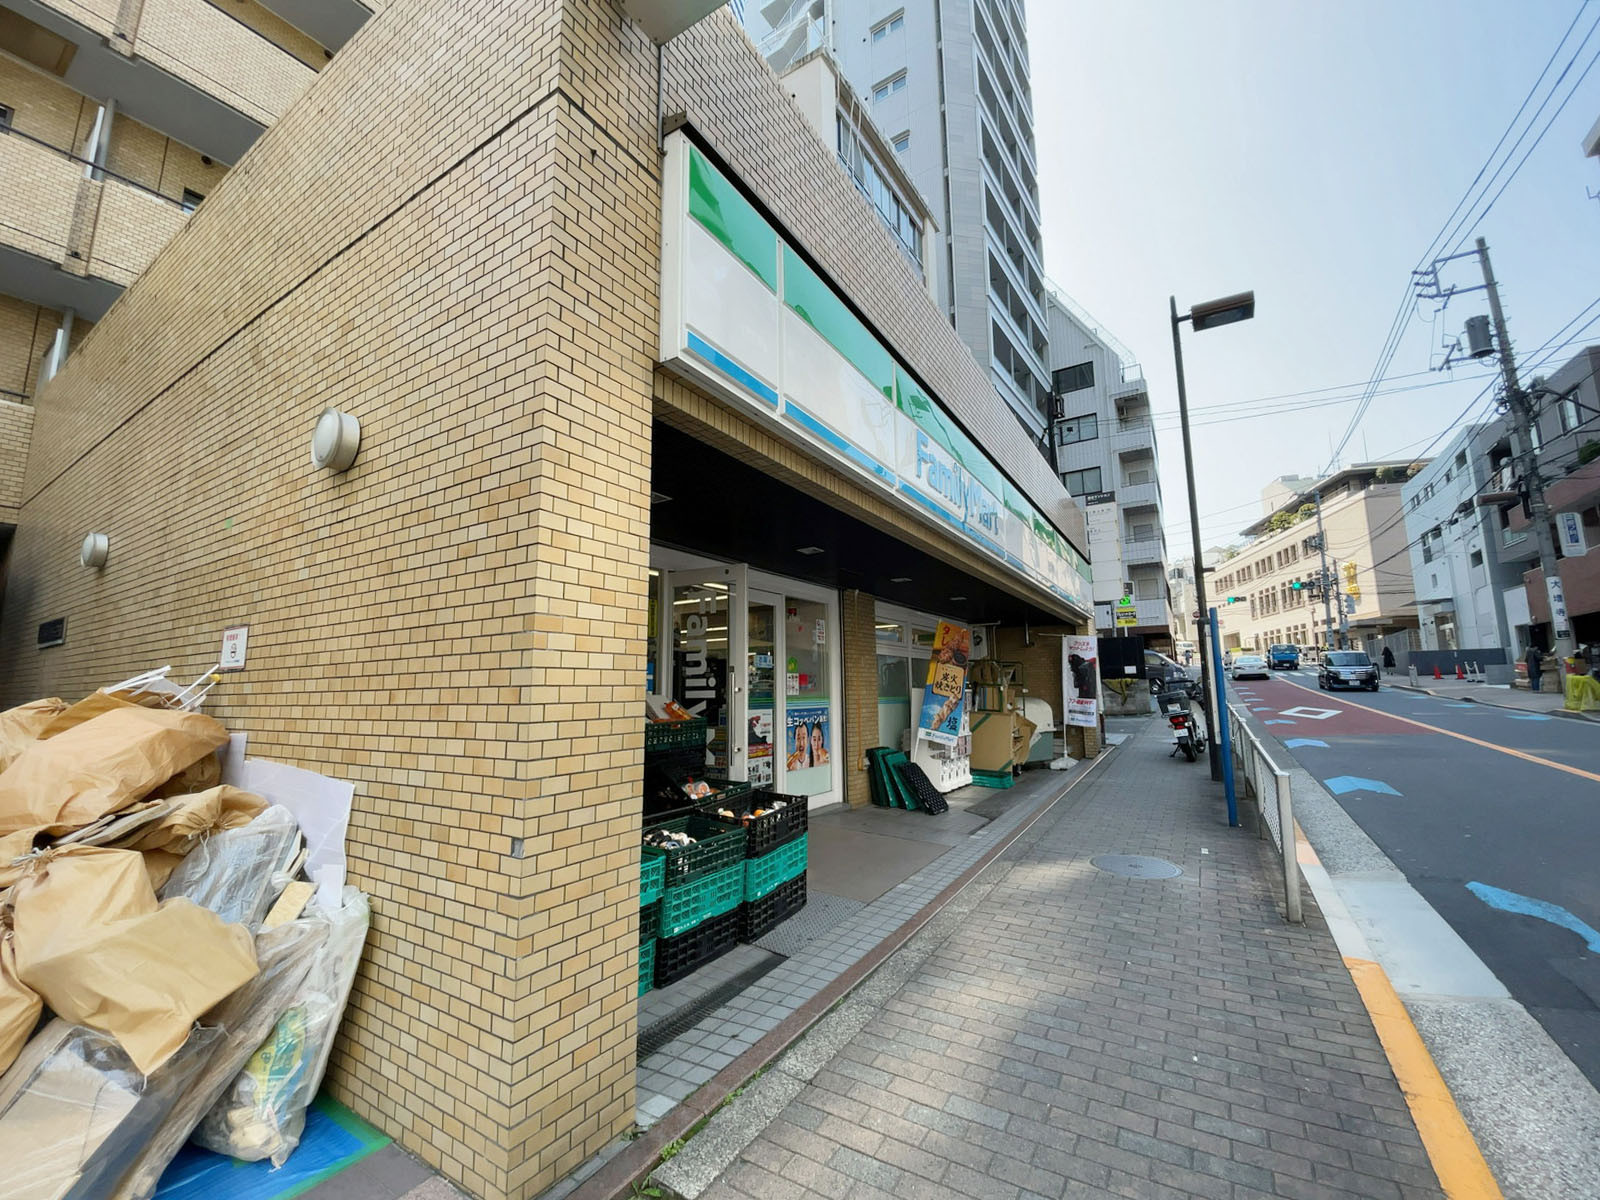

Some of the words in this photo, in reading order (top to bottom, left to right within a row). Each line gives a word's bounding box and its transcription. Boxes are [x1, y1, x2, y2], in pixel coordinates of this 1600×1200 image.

[916, 429, 999, 535] FamilyMart
[941, 671, 958, 685] 炭火
[934, 681, 962, 696] 焼きとり
[946, 716, 958, 732] 塩
